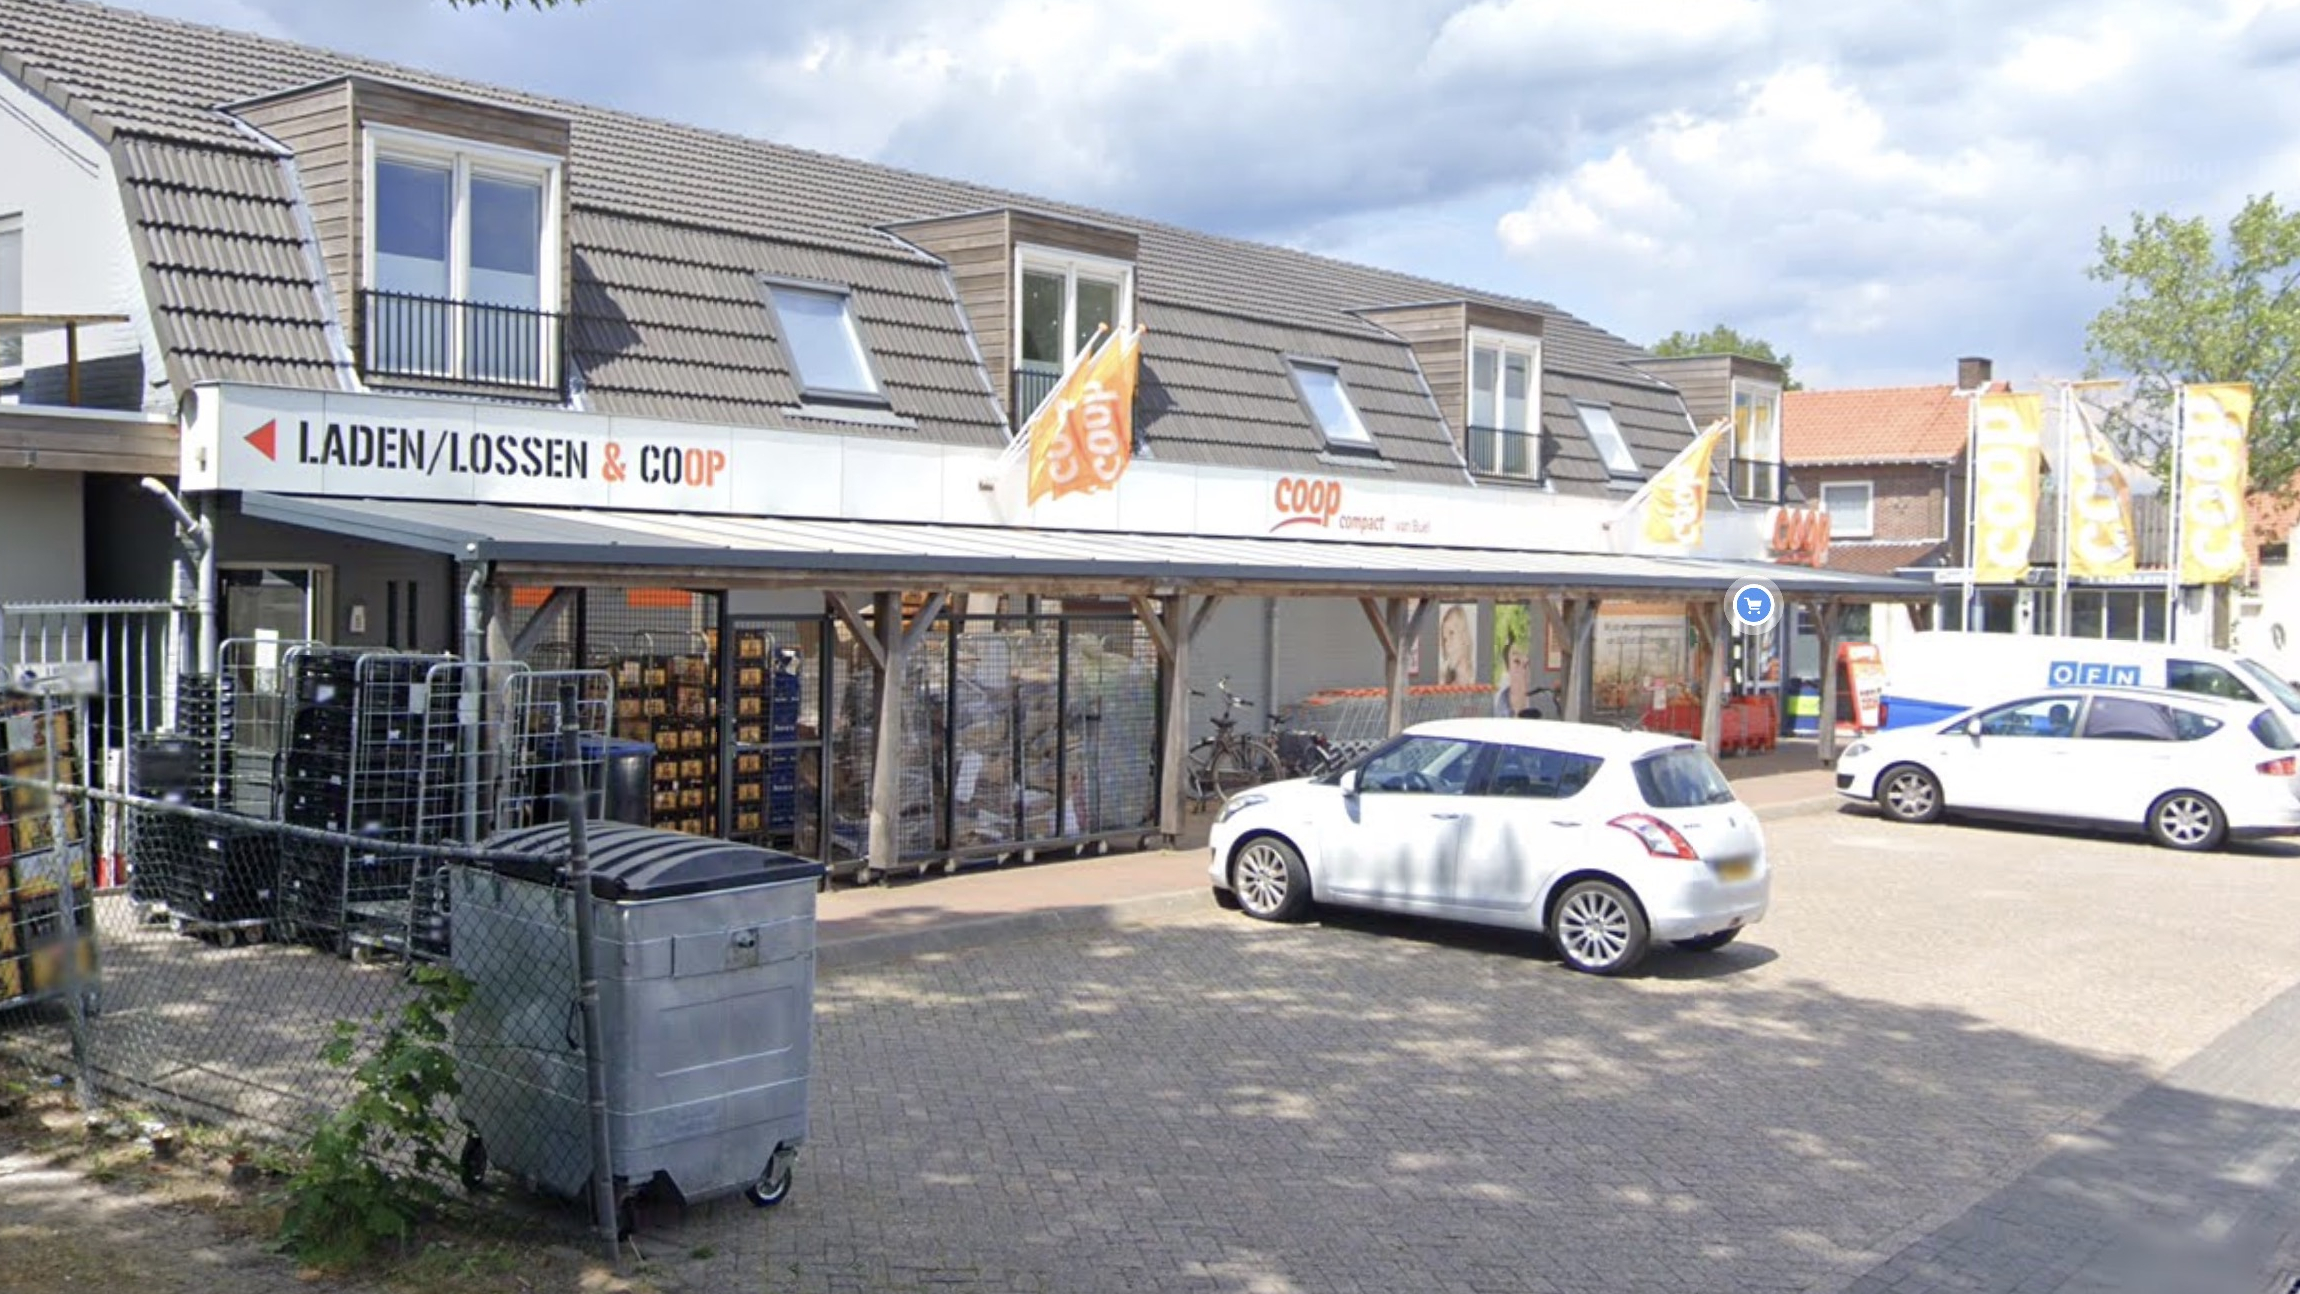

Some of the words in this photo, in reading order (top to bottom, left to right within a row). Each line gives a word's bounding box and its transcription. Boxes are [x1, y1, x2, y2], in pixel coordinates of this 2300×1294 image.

[299, 420, 588, 480] LADEN/LOSSEN
[601, 442, 626, 482] &
[640, 444, 726, 487] COOP
[1083, 379, 1122, 482] coop
[1275, 477, 1342, 528] coop
[1978, 405, 2040, 568] coop
[2184, 390, 2246, 568] coop
[1339, 514, 1385, 534] compact
[2052, 664, 2136, 686] OFN
